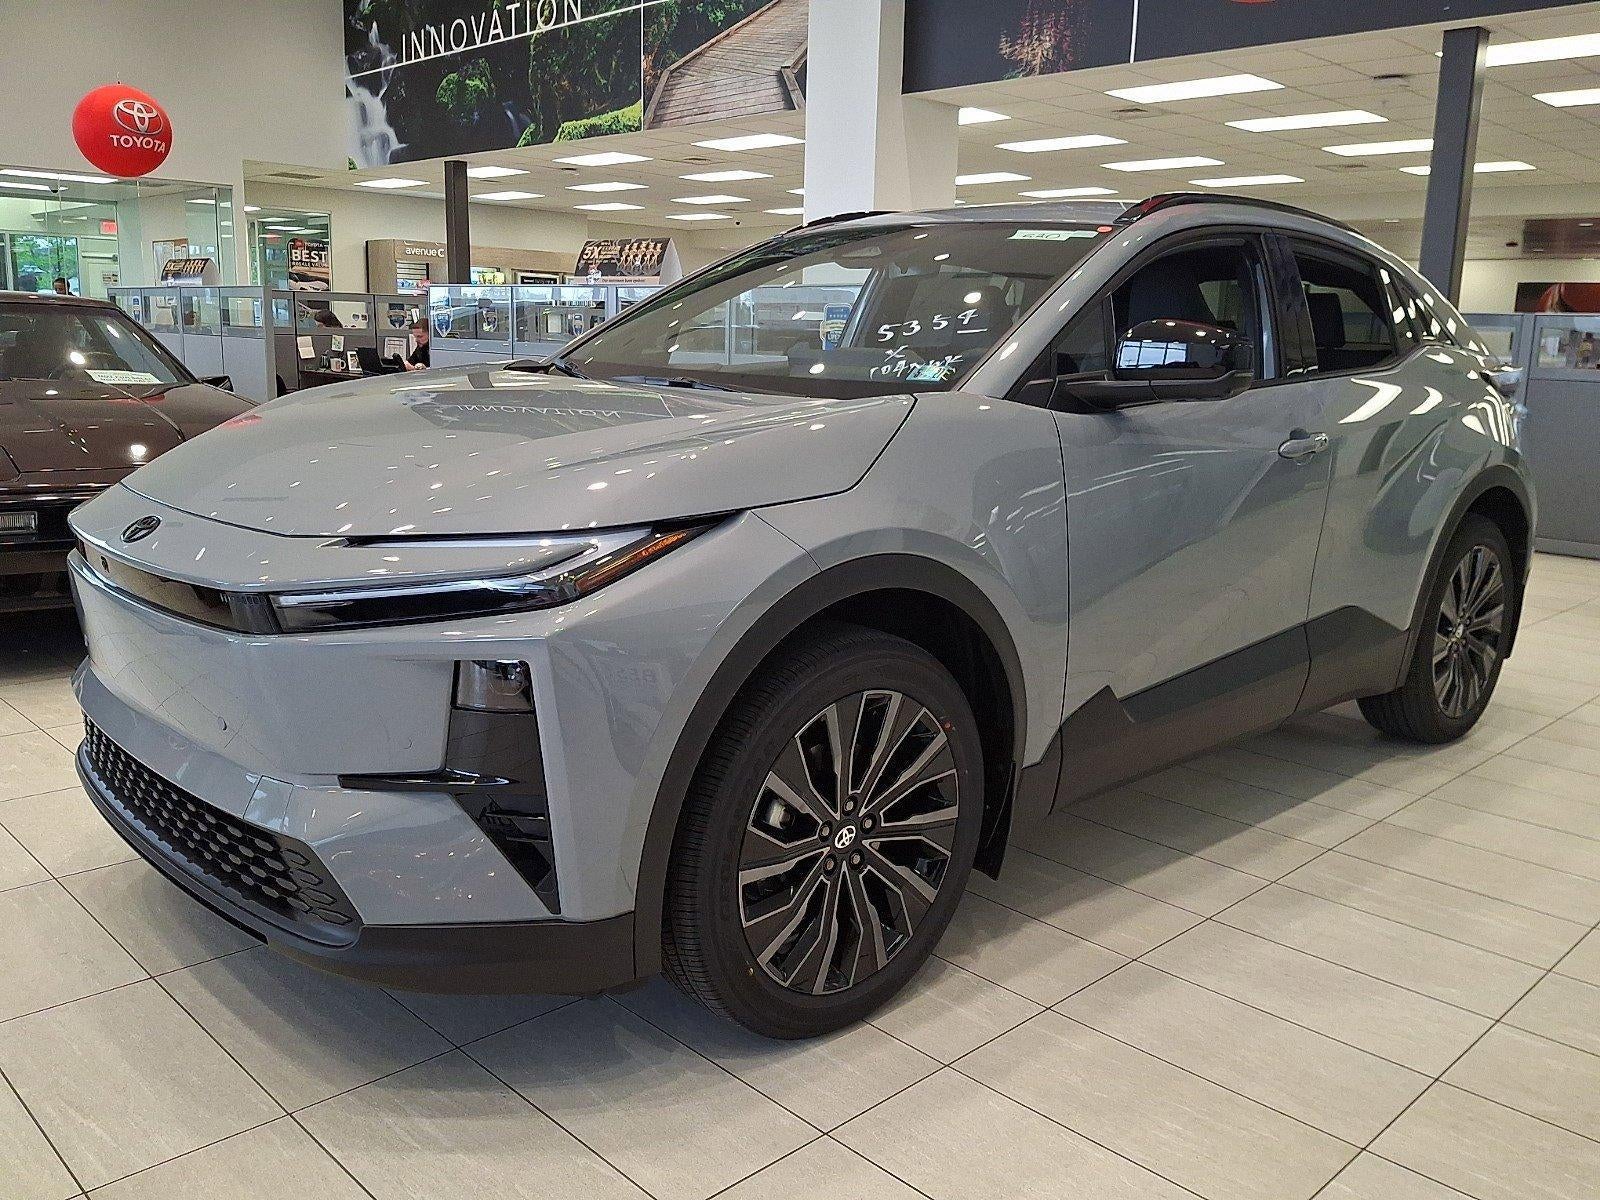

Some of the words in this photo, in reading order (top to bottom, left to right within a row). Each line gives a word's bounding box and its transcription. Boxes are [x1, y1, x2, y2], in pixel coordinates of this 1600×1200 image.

[401, 0, 582, 63] INNOVATION
[109, 134, 166, 154] TOYOTA
[291, 249, 328, 263] BEST
